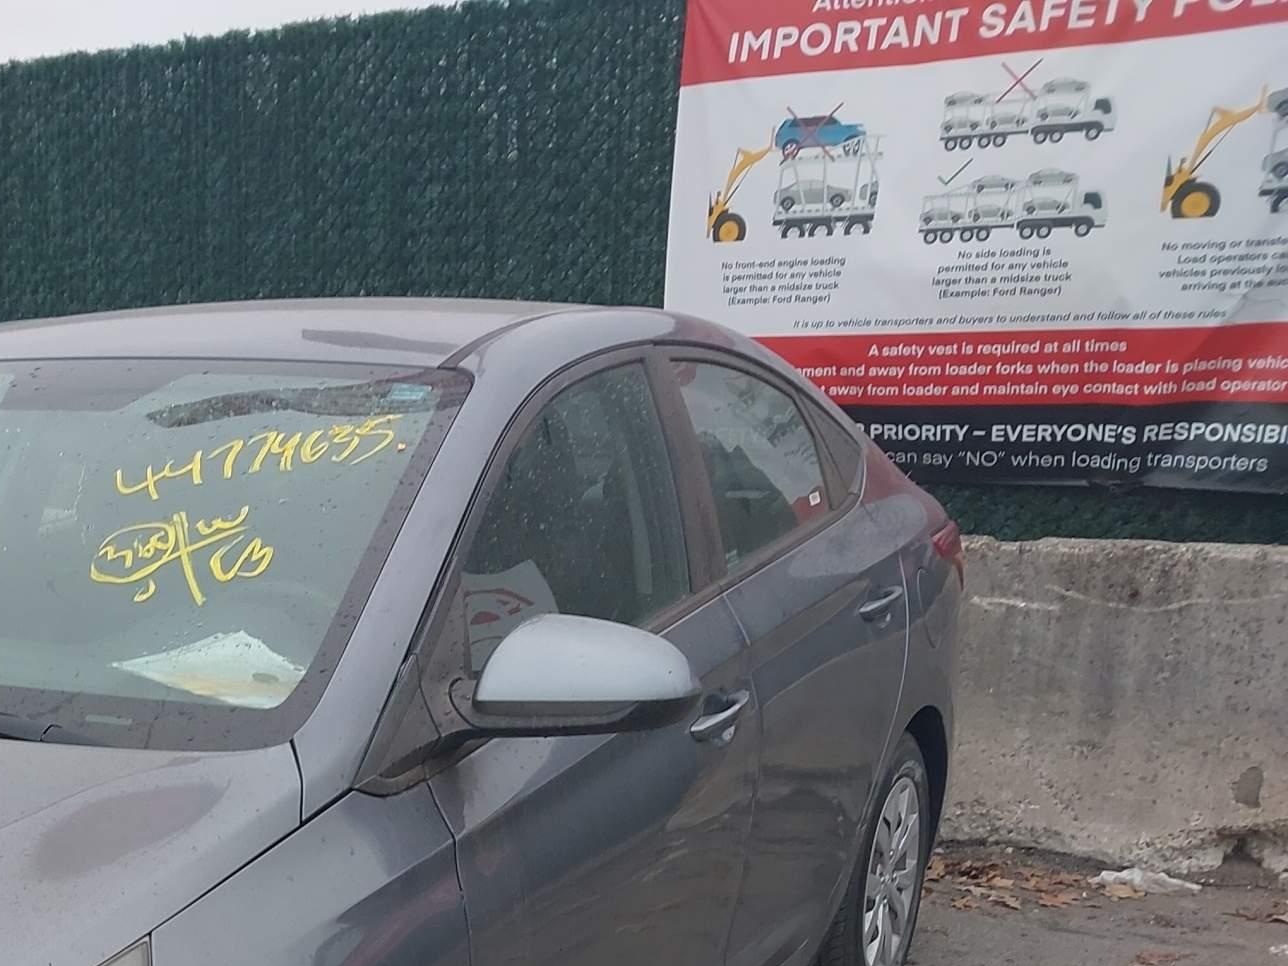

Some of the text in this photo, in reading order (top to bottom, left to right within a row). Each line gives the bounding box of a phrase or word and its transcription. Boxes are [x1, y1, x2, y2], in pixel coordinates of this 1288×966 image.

[728, 8, 969, 63] IMPORTANT
[1161, 241, 1178, 251] No
[1181, 240, 1226, 251] moving
[1229, 240, 1242, 249] or
[957, 246, 1051, 260] No side loading is
[1177, 254, 1207, 264] Load
[1209, 251, 1268, 264] operators
[721, 261, 733, 270] No
[777, 258, 809, 269] engine
[810, 256, 846, 267] loading
[937, 259, 1069, 274] permitted for any vehicle
[722, 269, 842, 283] is permitted for any vehicle
[1159, 267, 1206, 278] vehicles
[1209, 265, 1273, 278] previously
[932, 272, 1072, 287] larger than a midsize truck
[1181, 281, 1226, 291] arriving
[1229, 280, 1241, 289] at
[1244, 279, 1263, 288] the
[723, 284, 747, 294] larger
[749, 283, 768, 292] than
[778, 281, 813, 291] midsize
[815, 280, 839, 290] truck
[938, 285, 1062, 299] (Example: Ford Ranger)
[772, 294, 793, 304] Ford
[794, 293, 831, 304] Ranger)
[793, 308, 1227, 330] It is up to vehicle transporters and buyers to understand and follow all of these rules
[868, 338, 1128, 358] A safety vest is required at all times
[839, 364, 865, 377] and
[868, 365, 905, 379] away
[908, 362, 941, 377] from
[945, 362, 992, 376] loader
[995, 361, 1033, 375] forks
[1037, 359, 1079, 374] when
[1083, 359, 1109, 373] the
[1112, 359, 1162, 374] loader
[1165, 359, 1179, 374] is
[1182, 356, 1243, 375] placing
[828, 384, 864, 397] away
[867, 383, 899, 397] from
[903, 383, 948, 397] loader
[951, 382, 980, 396] and
[983, 380, 1048, 395] maintain
[1052, 383, 1079, 397] eye
[1083, 382, 1140, 395] contact
[1143, 381, 1178, 395] with
[1181, 377, 1217, 393] load
[870, 423, 969, 442] PRIORITY
[991, 424, 1137, 445] EVERYONE'S
[887, 452, 917, 464] can
[922, 452, 953, 468] say
[1011, 451, 1065, 468] when
[1072, 451, 1141, 473] loading
[1147, 453, 1269, 472] transporters
